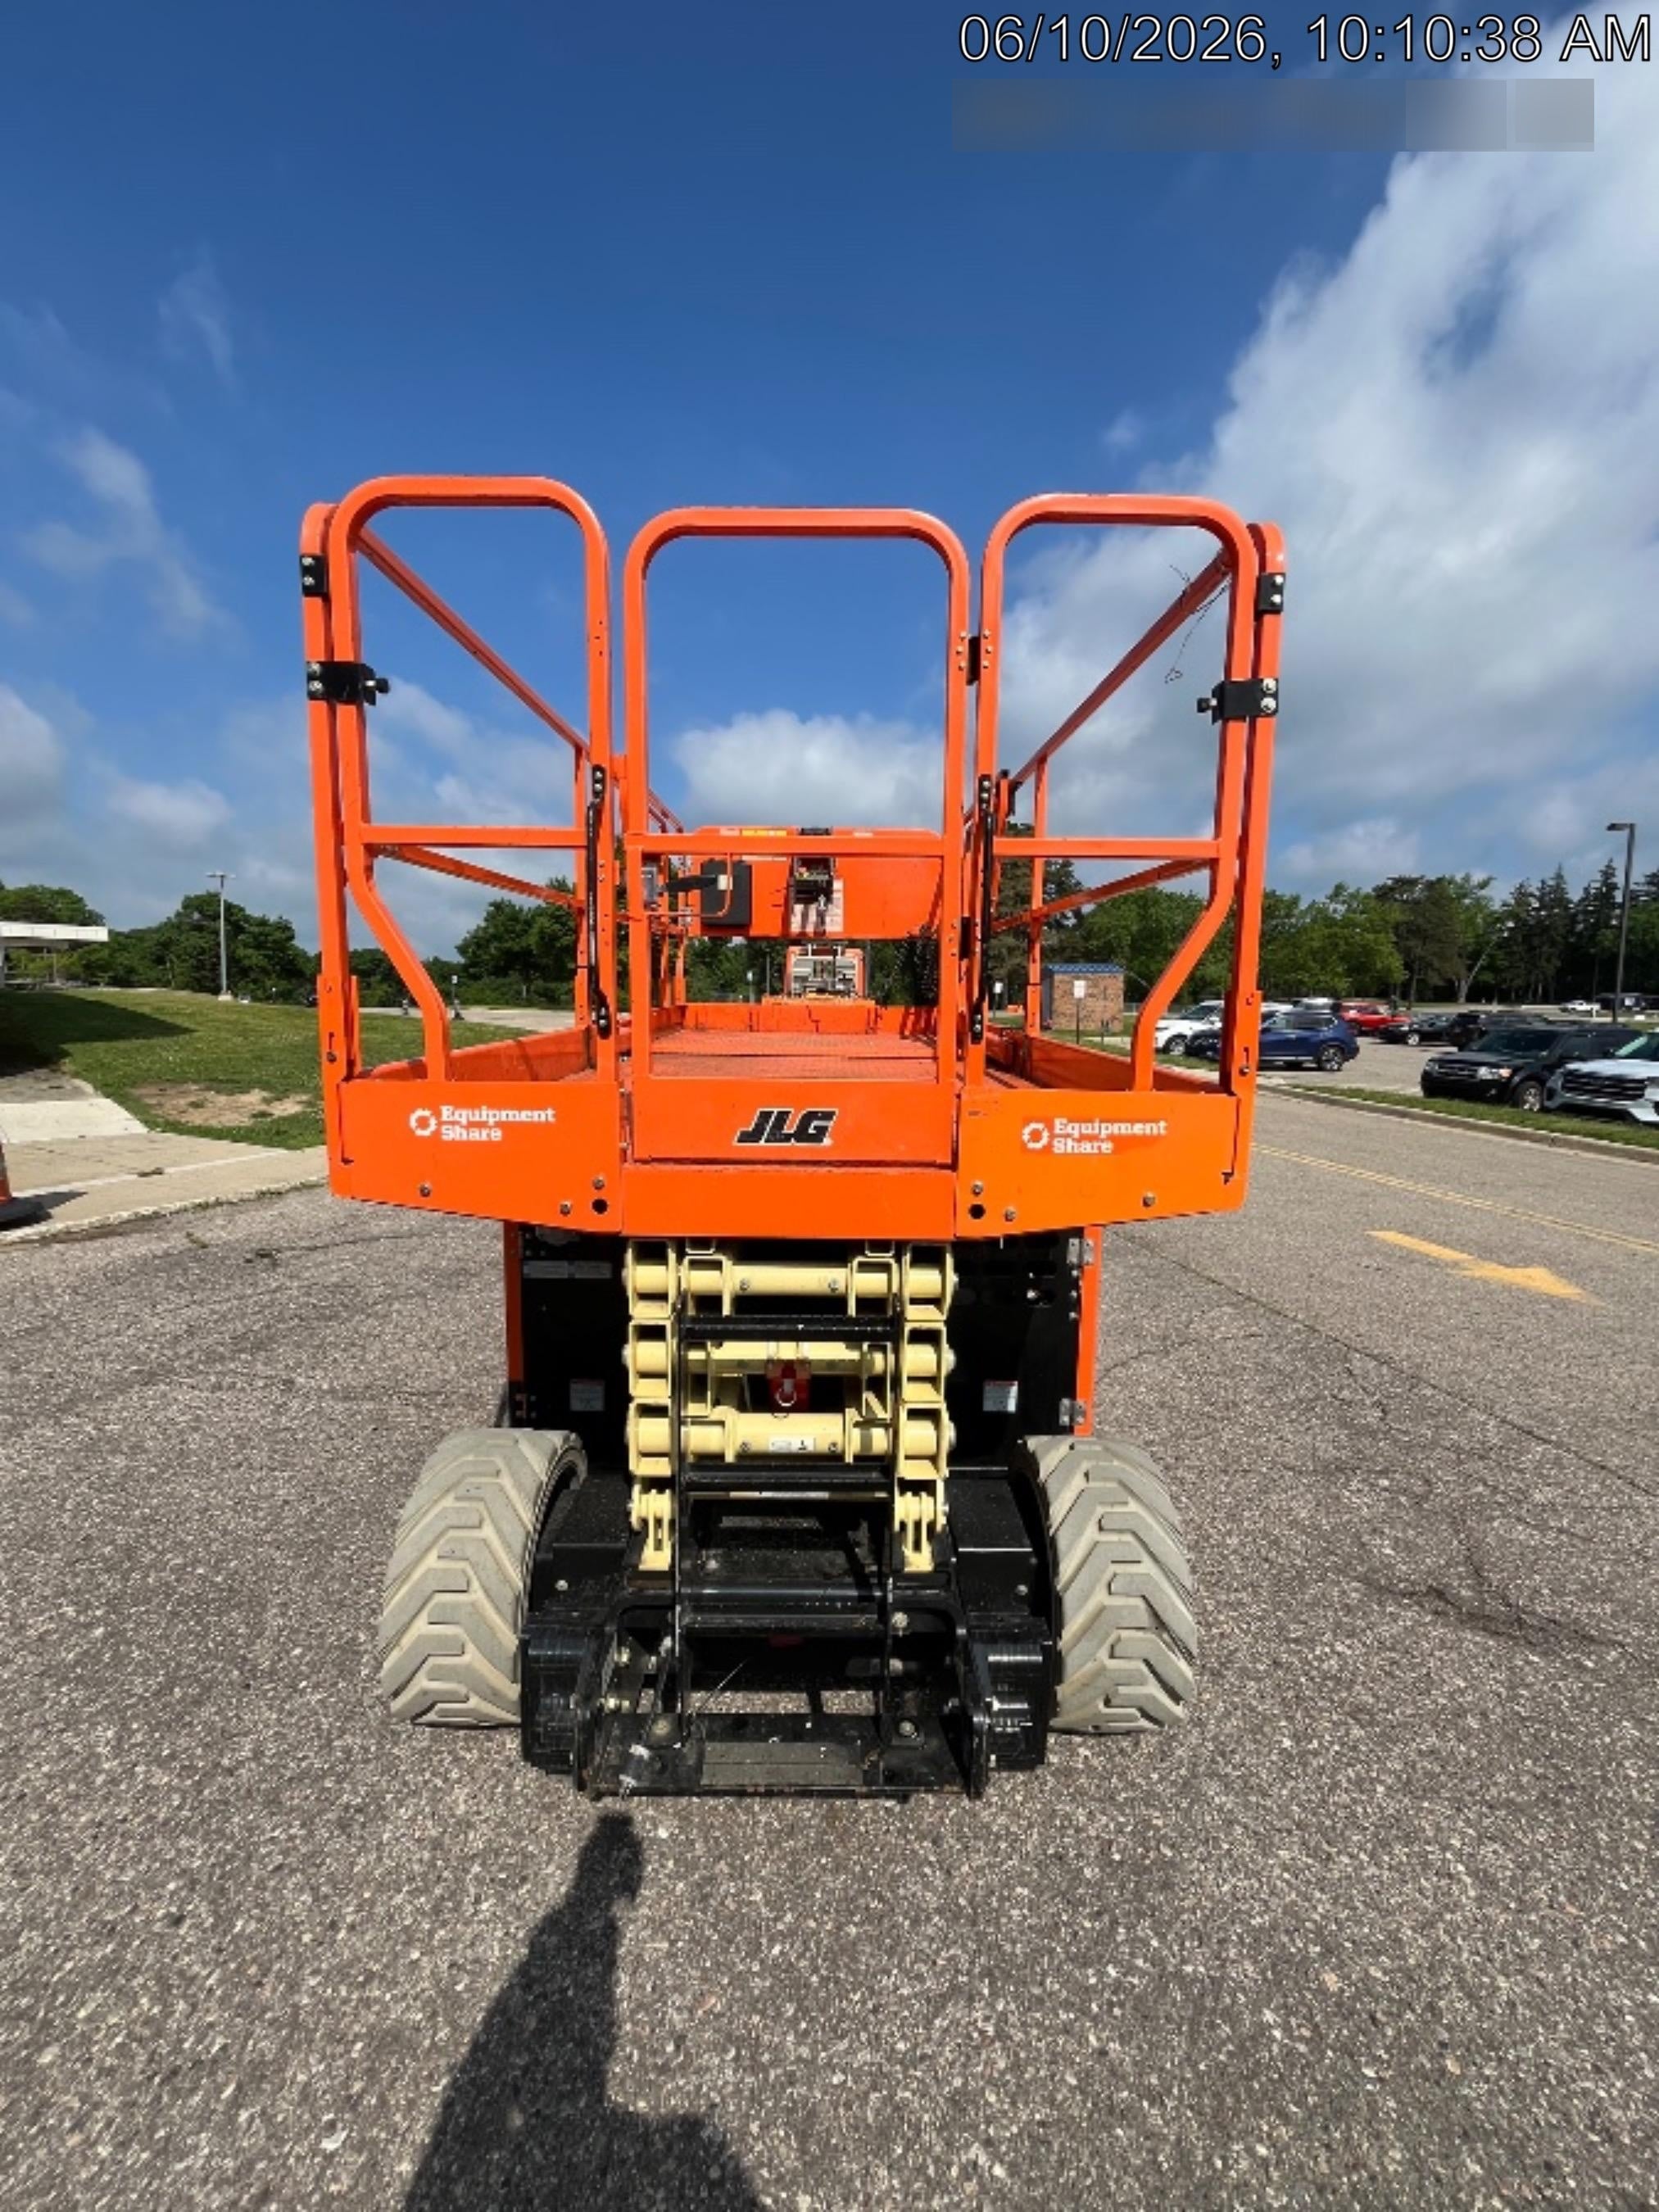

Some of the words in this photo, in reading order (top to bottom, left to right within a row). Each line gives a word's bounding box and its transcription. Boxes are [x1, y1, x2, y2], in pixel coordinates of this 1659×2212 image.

[441, 1106, 555, 1124] Equipment
[441, 1125, 502, 1141] Share
[734, 1108, 837, 1145] JLG
[1054, 1118, 1167, 1137] Equipment
[1053, 1137, 1113, 1154] Share
